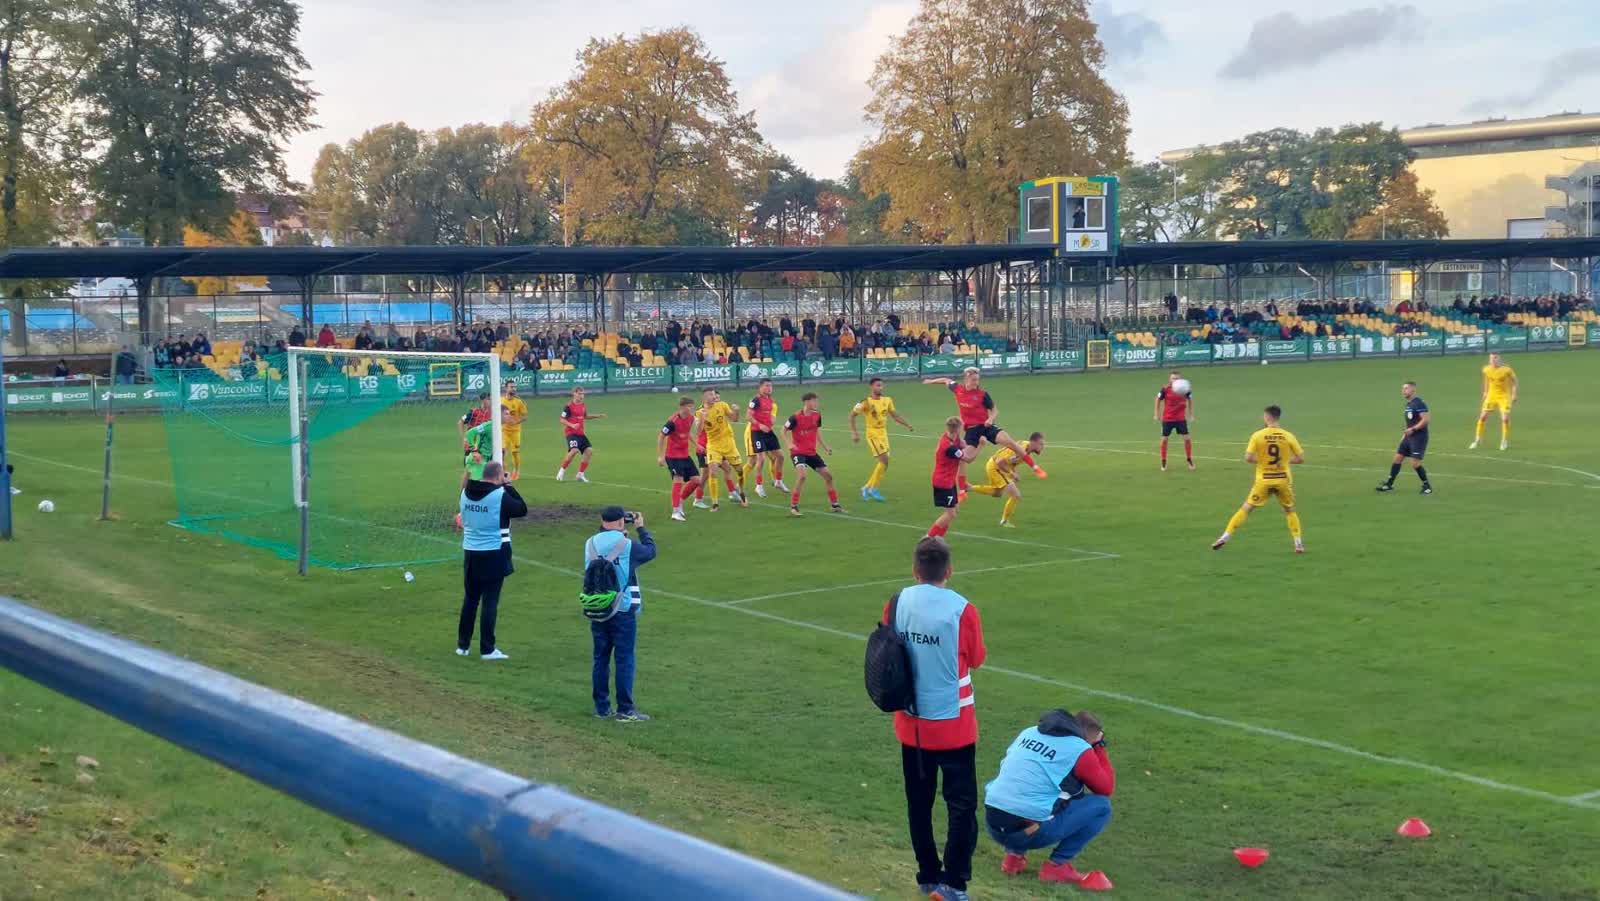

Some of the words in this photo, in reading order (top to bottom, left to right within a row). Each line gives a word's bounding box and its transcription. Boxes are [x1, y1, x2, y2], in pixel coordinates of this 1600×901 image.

[1126, 348, 1156, 360] DIRKS
[694, 366, 731, 378] DIRKS
[210, 384, 264, 396] Vancooler
[755, 440, 762, 449] 9
[1268, 443, 1280, 465] 9
[947, 495, 954, 506] 7
[464, 503, 489, 514] MEDIA
[911, 631, 940, 647] TEAM
[1018, 737, 1057, 761] MEDIA
